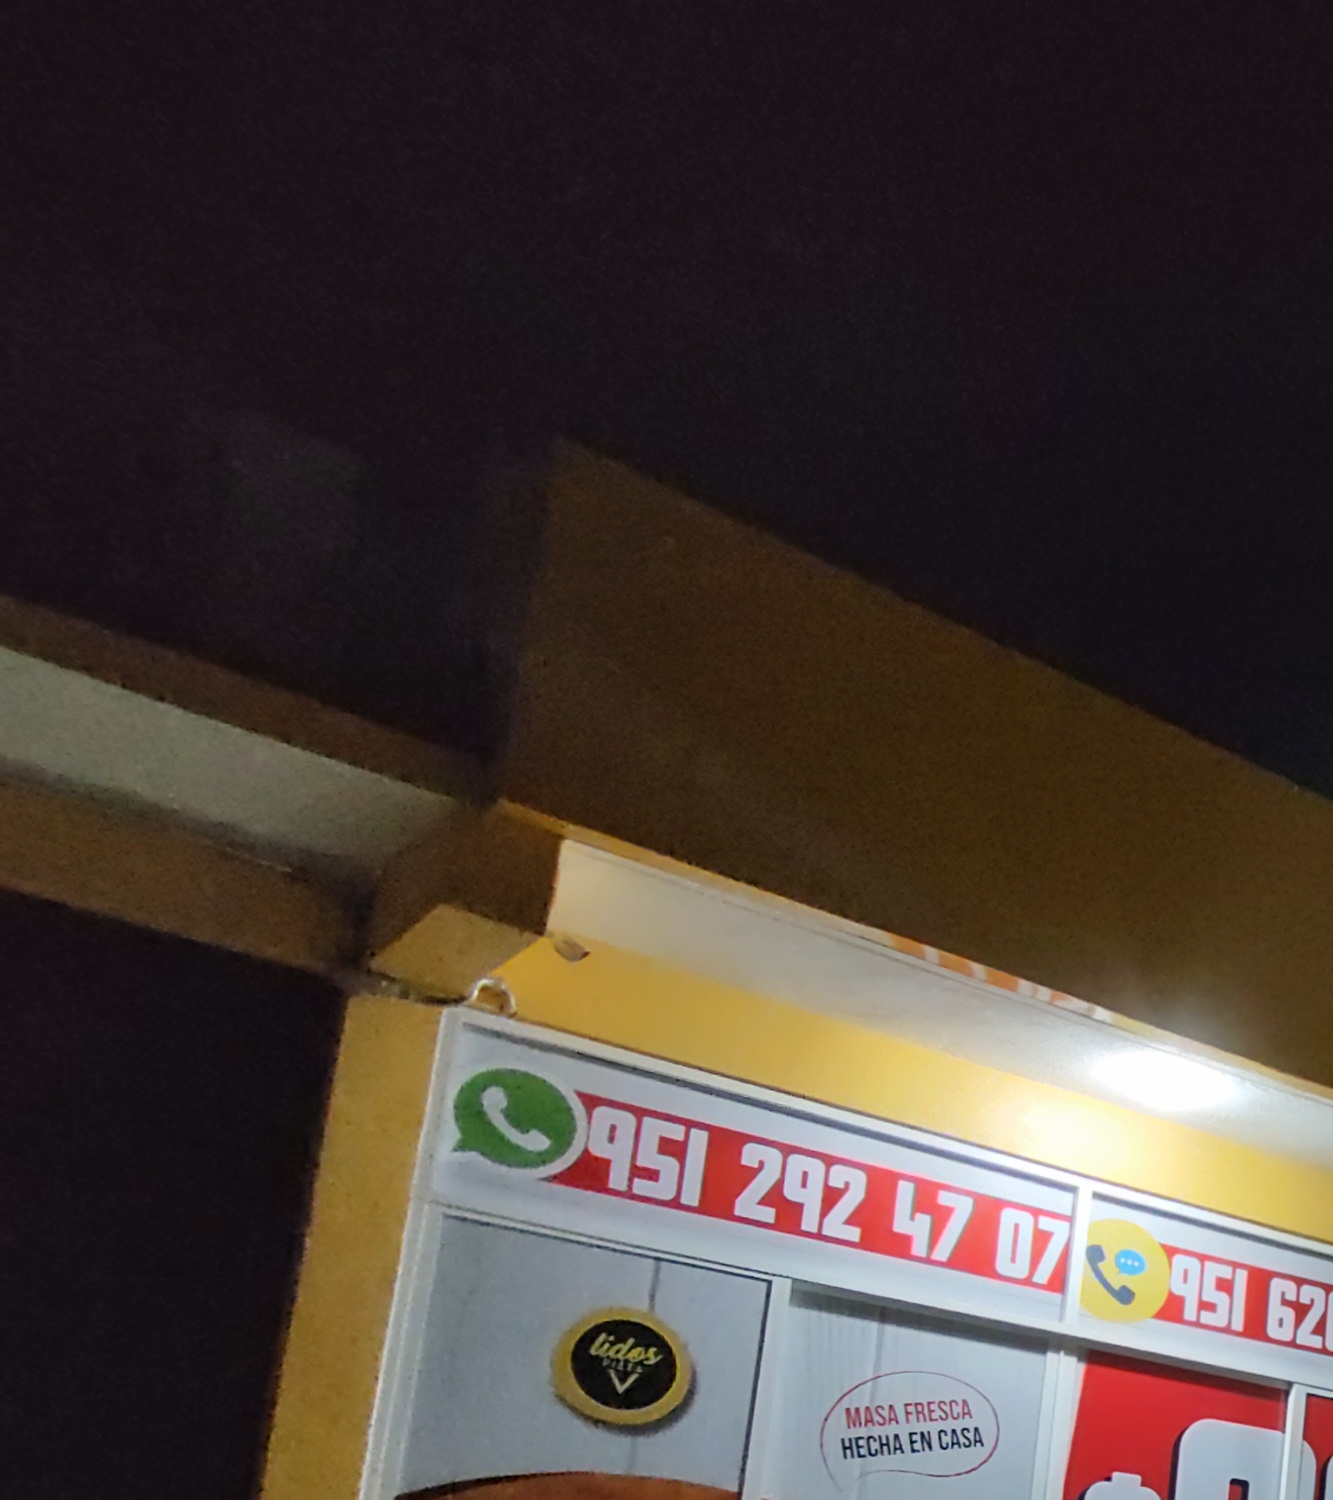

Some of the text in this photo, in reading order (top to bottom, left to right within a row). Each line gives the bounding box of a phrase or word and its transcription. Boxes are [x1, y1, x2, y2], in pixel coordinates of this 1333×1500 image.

[587, 1106, 1070, 1285] 951 292 47 07
[1170, 1254, 1248, 1333] 951
[589, 1332, 663, 1365] lidos
[846, 1398, 972, 1429] MASA FRESCA
[841, 1427, 985, 1460] HECHA EN CASA
